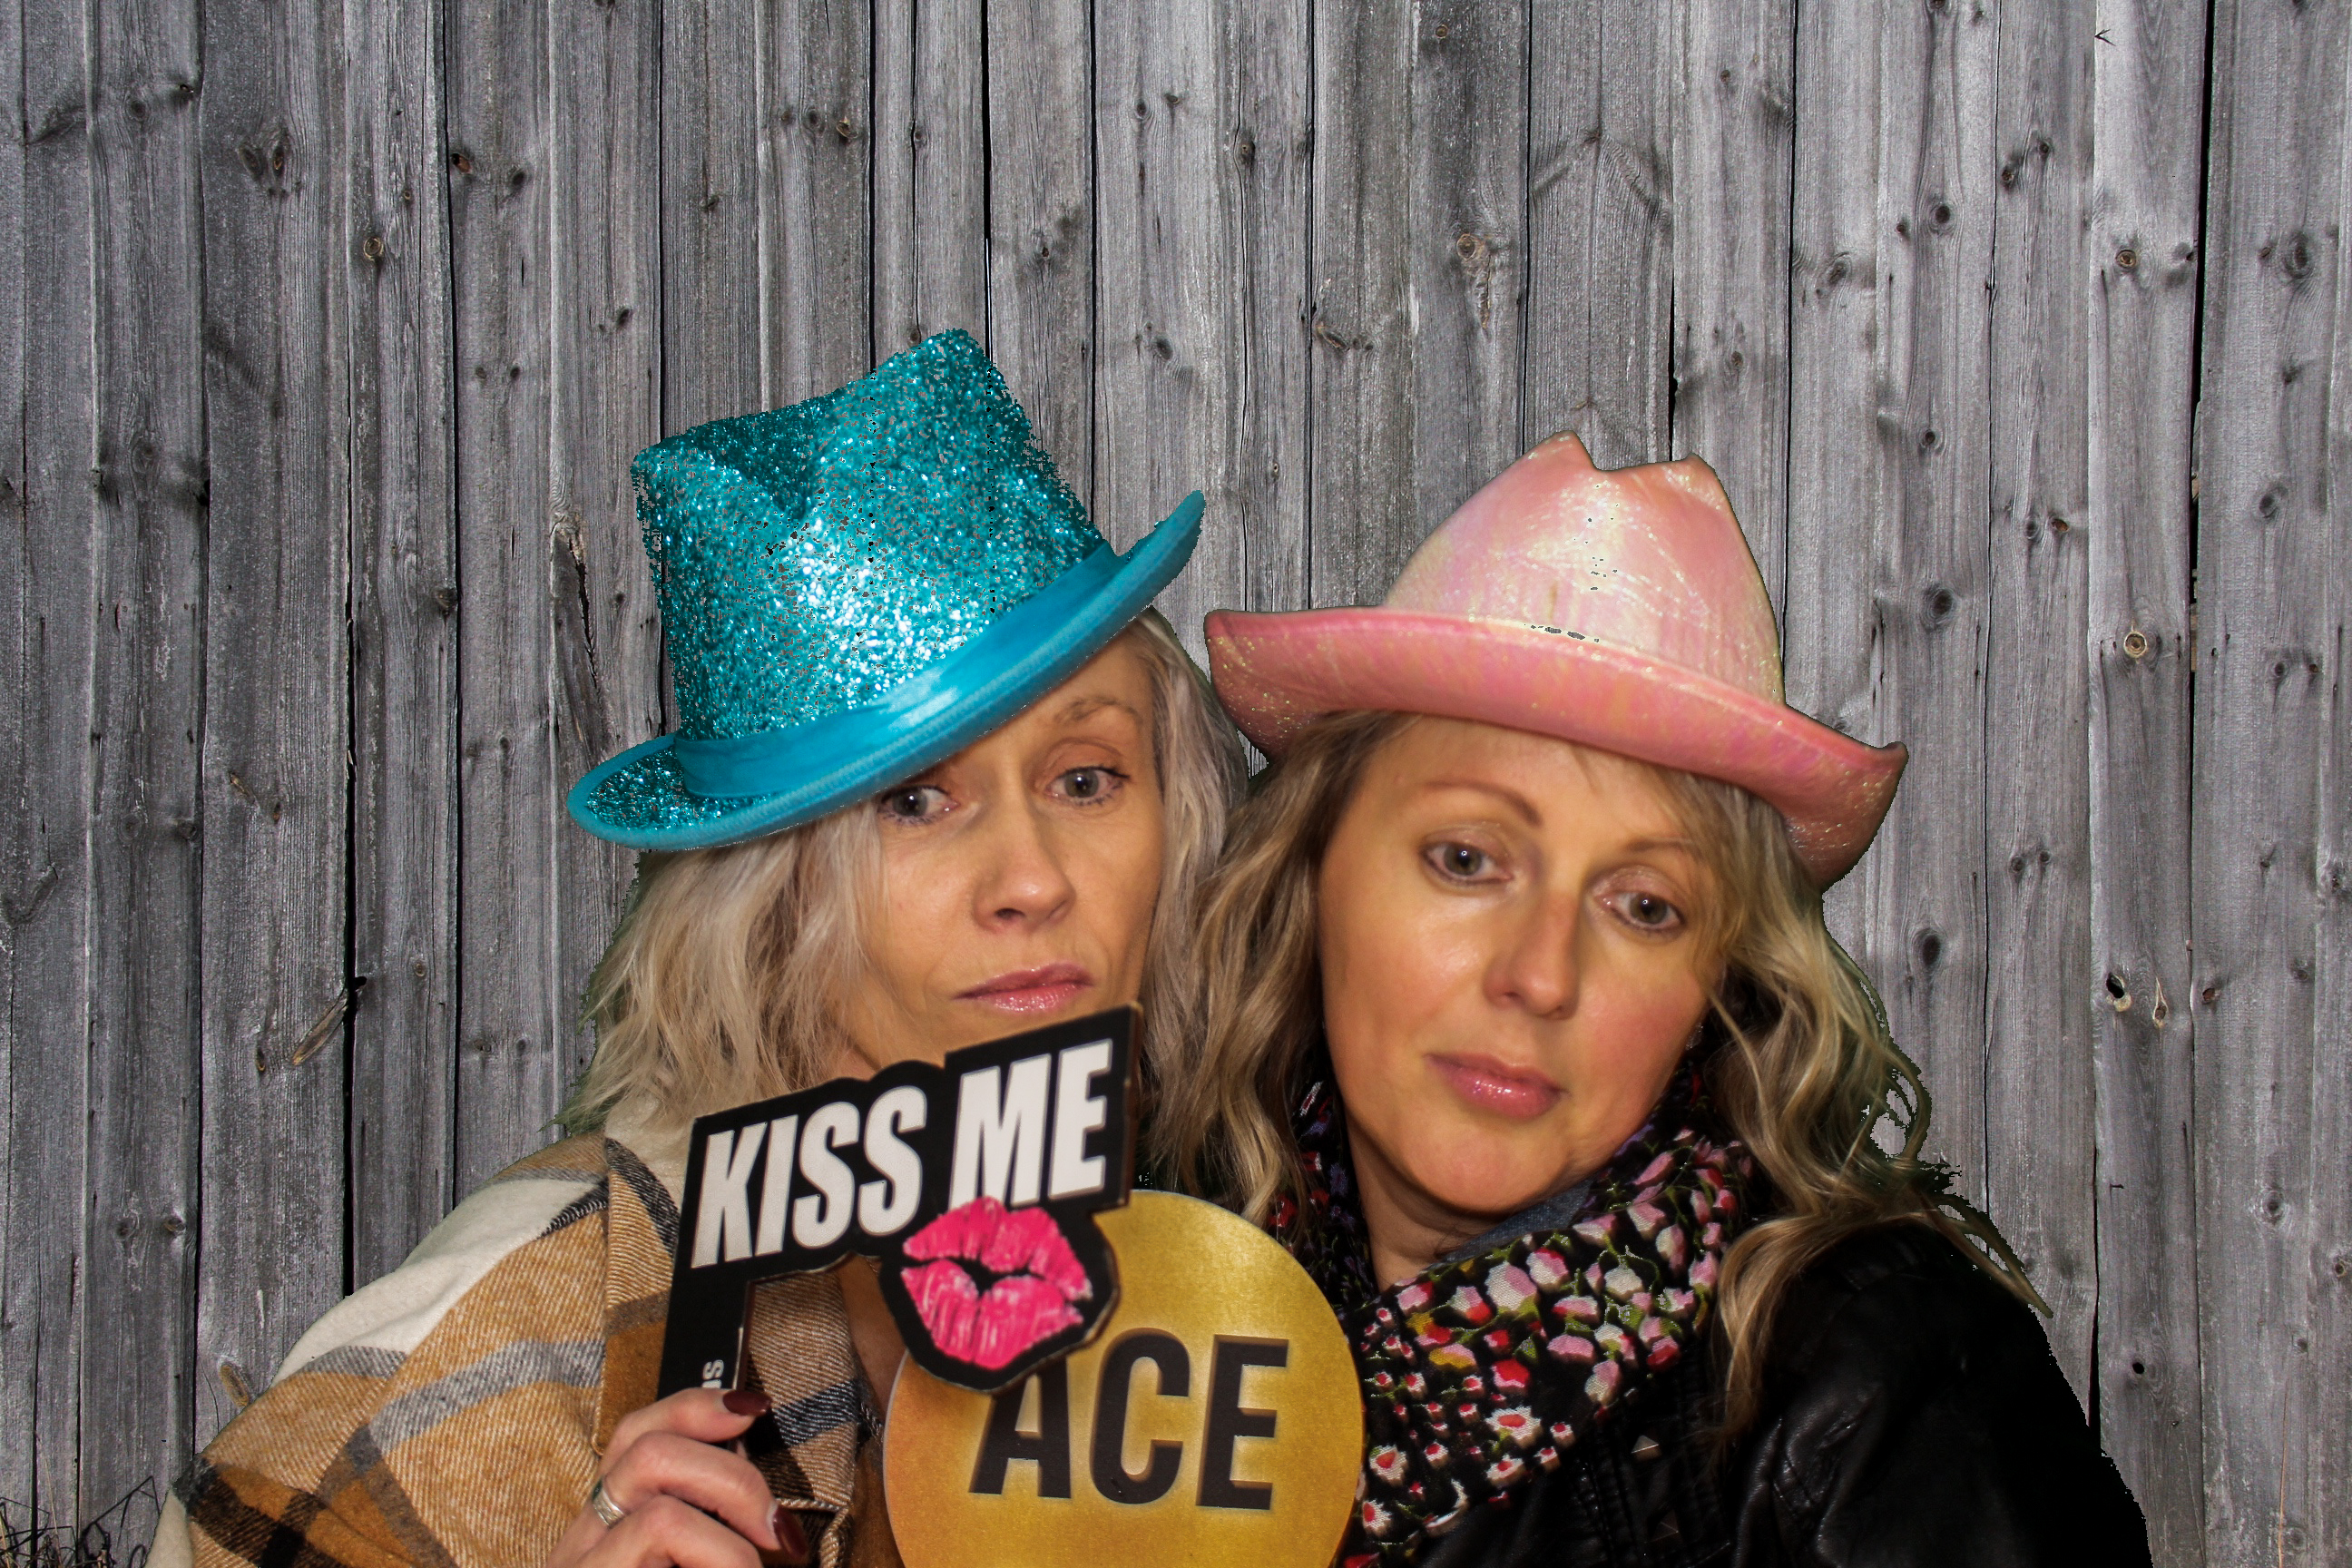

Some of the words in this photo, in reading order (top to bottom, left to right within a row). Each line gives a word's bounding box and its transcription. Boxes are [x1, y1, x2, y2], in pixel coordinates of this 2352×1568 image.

[691, 1085, 927, 1269] KISS
[948, 1038, 1112, 1212] ME
[968, 1328, 1289, 1510] ACE
